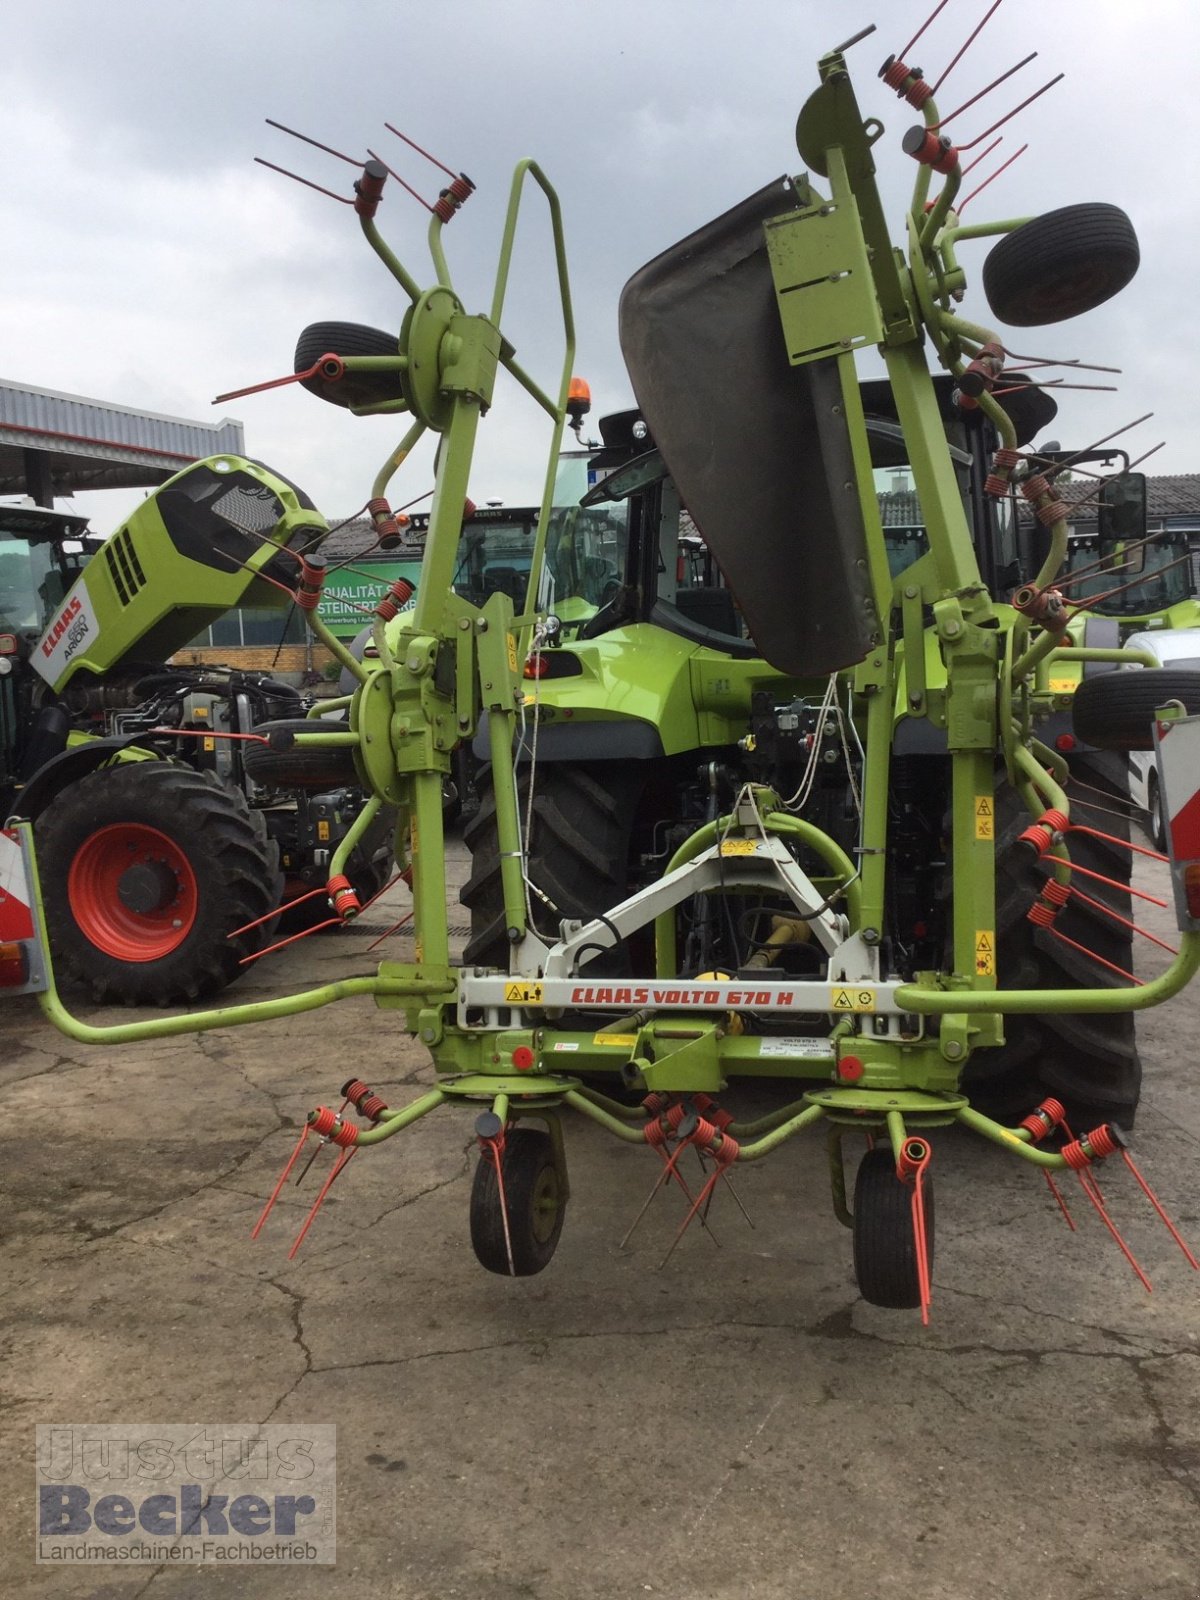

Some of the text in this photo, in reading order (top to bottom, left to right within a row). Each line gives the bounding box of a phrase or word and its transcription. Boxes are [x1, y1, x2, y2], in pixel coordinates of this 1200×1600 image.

[323, 583, 382, 599] QUALITÄT
[317, 601, 377, 614] STEINERT
[42, 596, 82, 658] CLAAS
[64, 624, 89, 660] ARION
[571, 987, 794, 1006] CLAAS VOLTO 670 H
